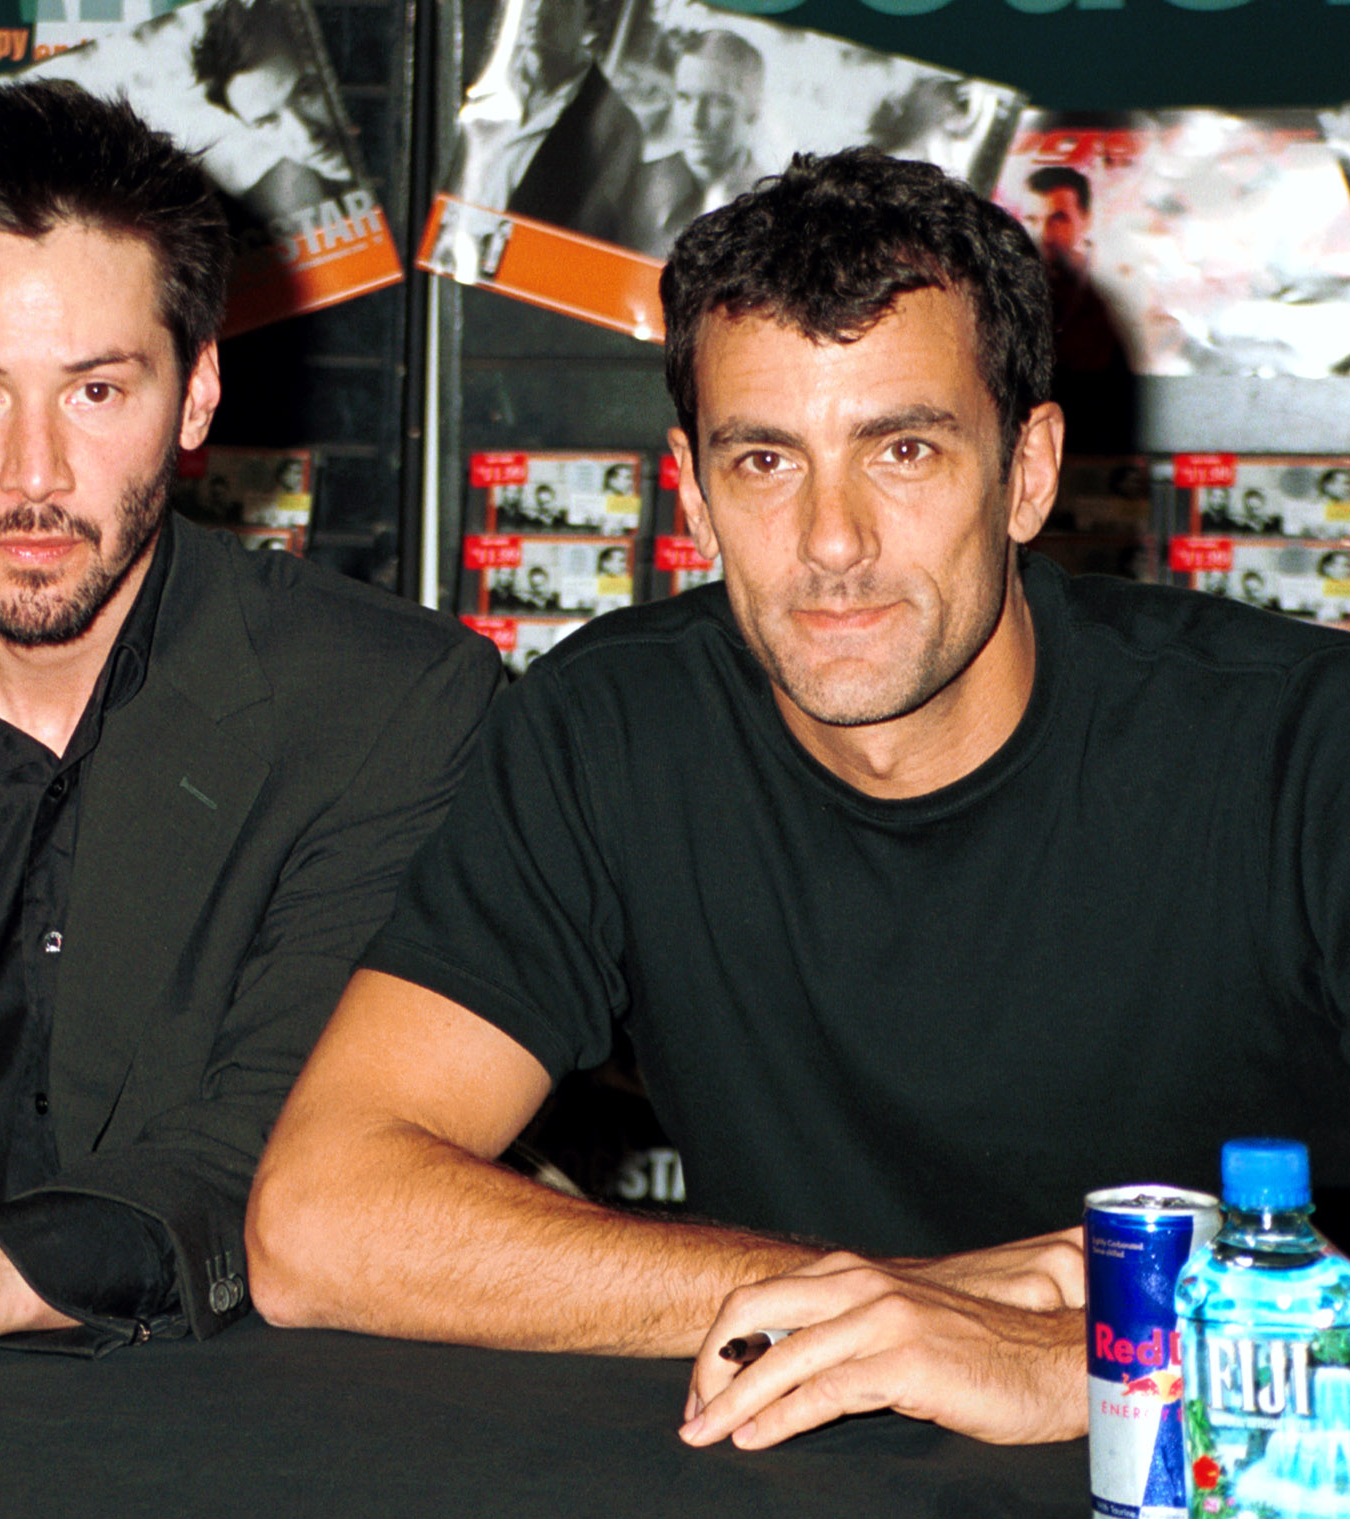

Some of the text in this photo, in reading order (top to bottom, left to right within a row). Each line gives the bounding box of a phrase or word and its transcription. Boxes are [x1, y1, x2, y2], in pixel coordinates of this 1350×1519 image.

[1095, 1322, 1163, 1366] Red
[1207, 1339, 1312, 1416] FIJI
[1101, 1400, 1169, 1422] ENERY
